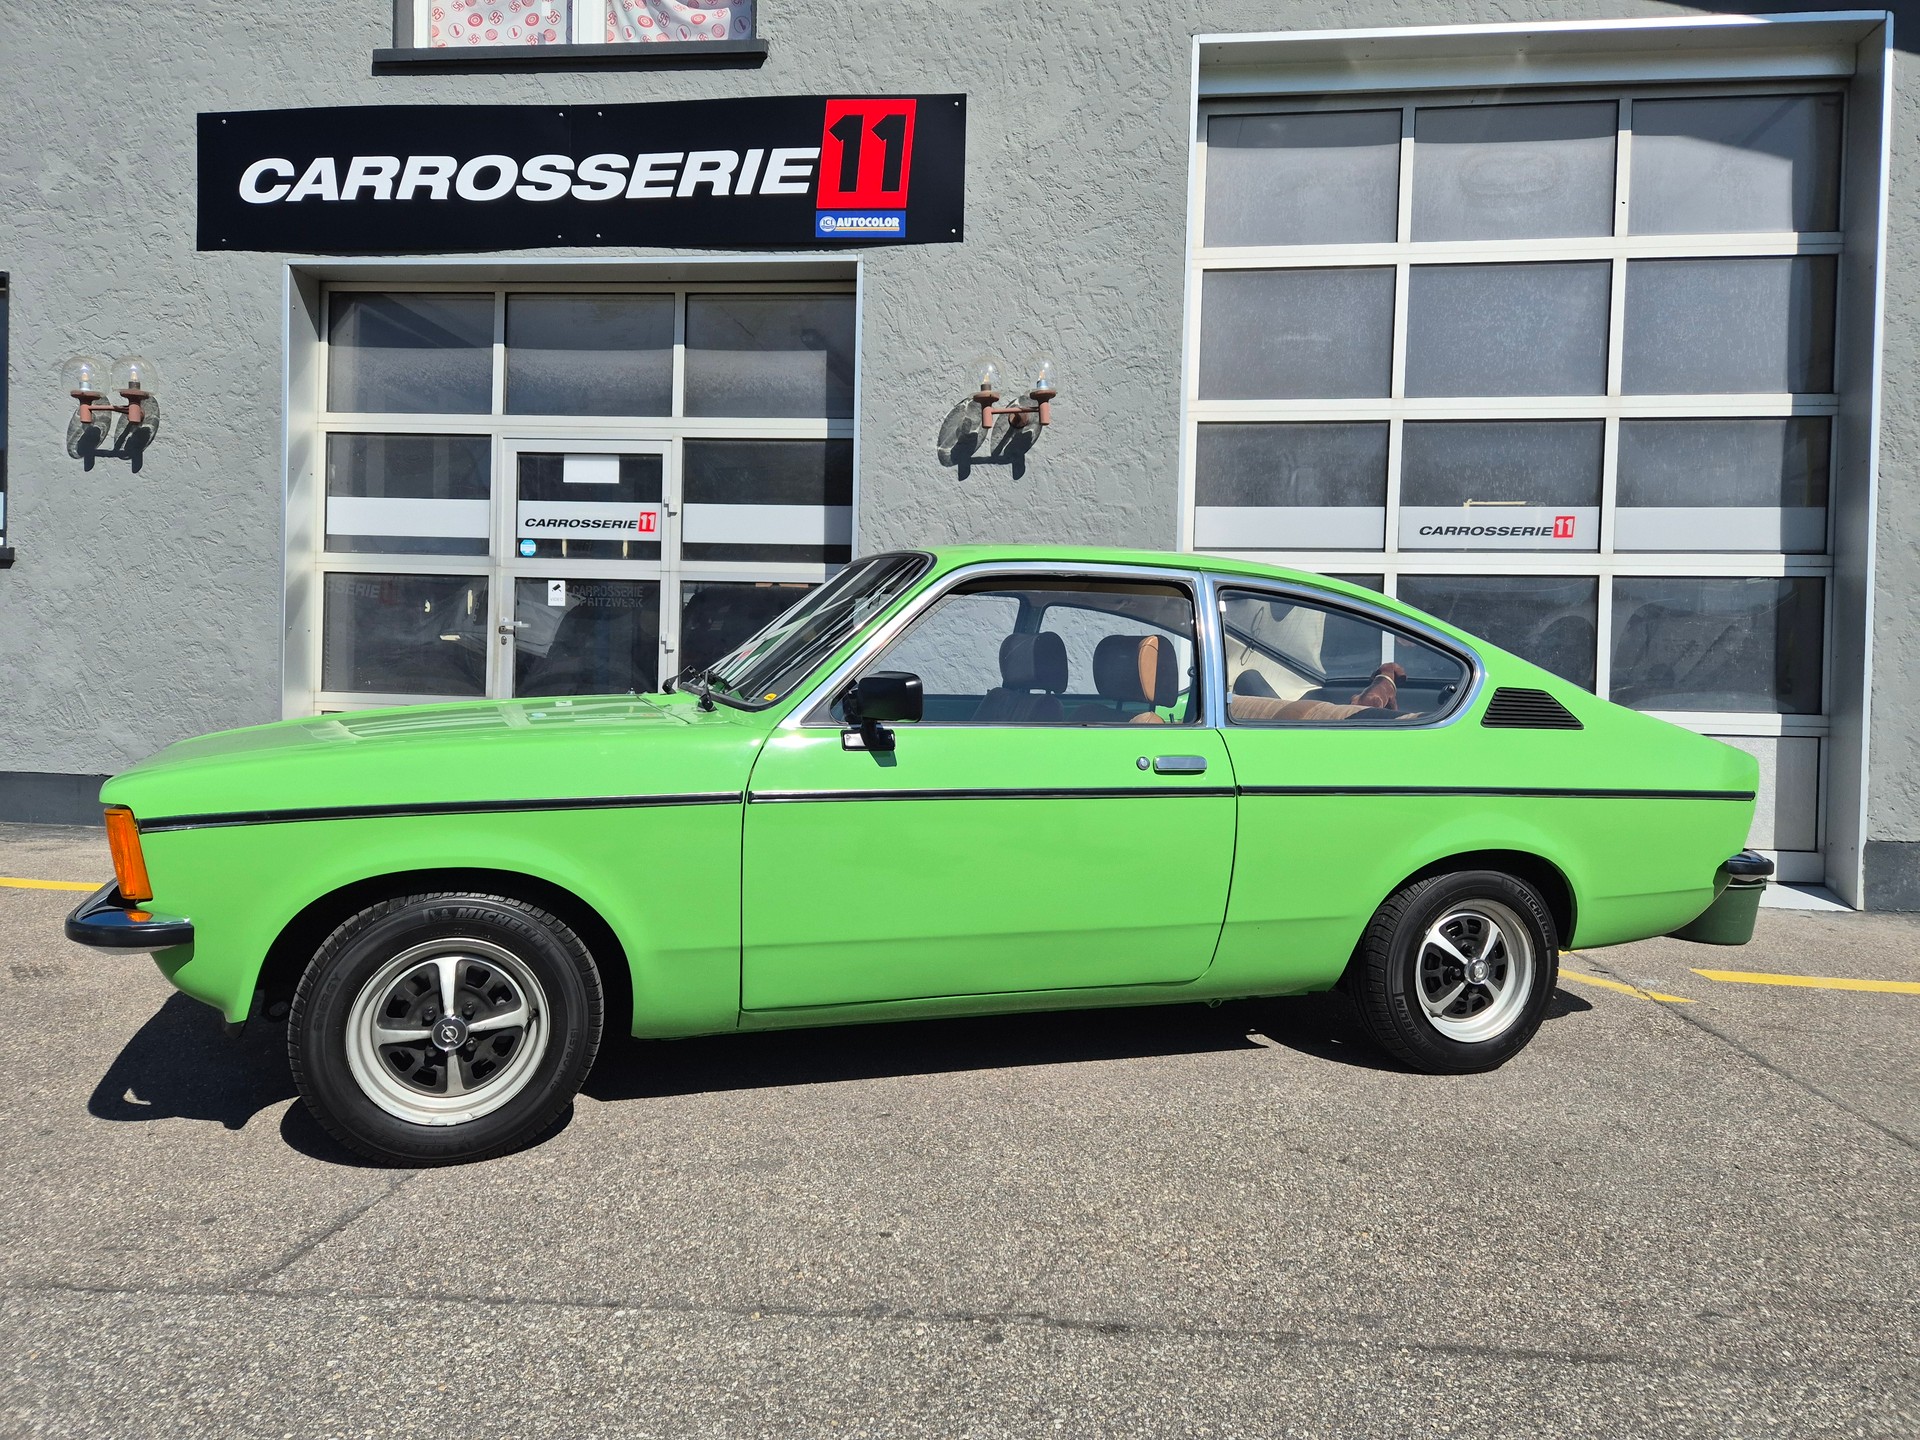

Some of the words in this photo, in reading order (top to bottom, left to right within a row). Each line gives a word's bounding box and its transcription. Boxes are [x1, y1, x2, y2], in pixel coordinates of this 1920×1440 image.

[490, 11, 503, 24] 95
[659, 12, 669, 26] 95
[239, 147, 821, 204] CARROSSERIE
[828, 113, 907, 193] 11
[836, 217, 900, 227] AUTOCOLOR
[525, 518, 638, 529] CARROSSERIE
[640, 513, 656, 531] 11
[1419, 525, 1554, 536] CARROSSERIE
[1556, 518, 1574, 536] 11
[456, 907, 549, 948] MICHELIN
[313, 973, 341, 1034] ENERGY
